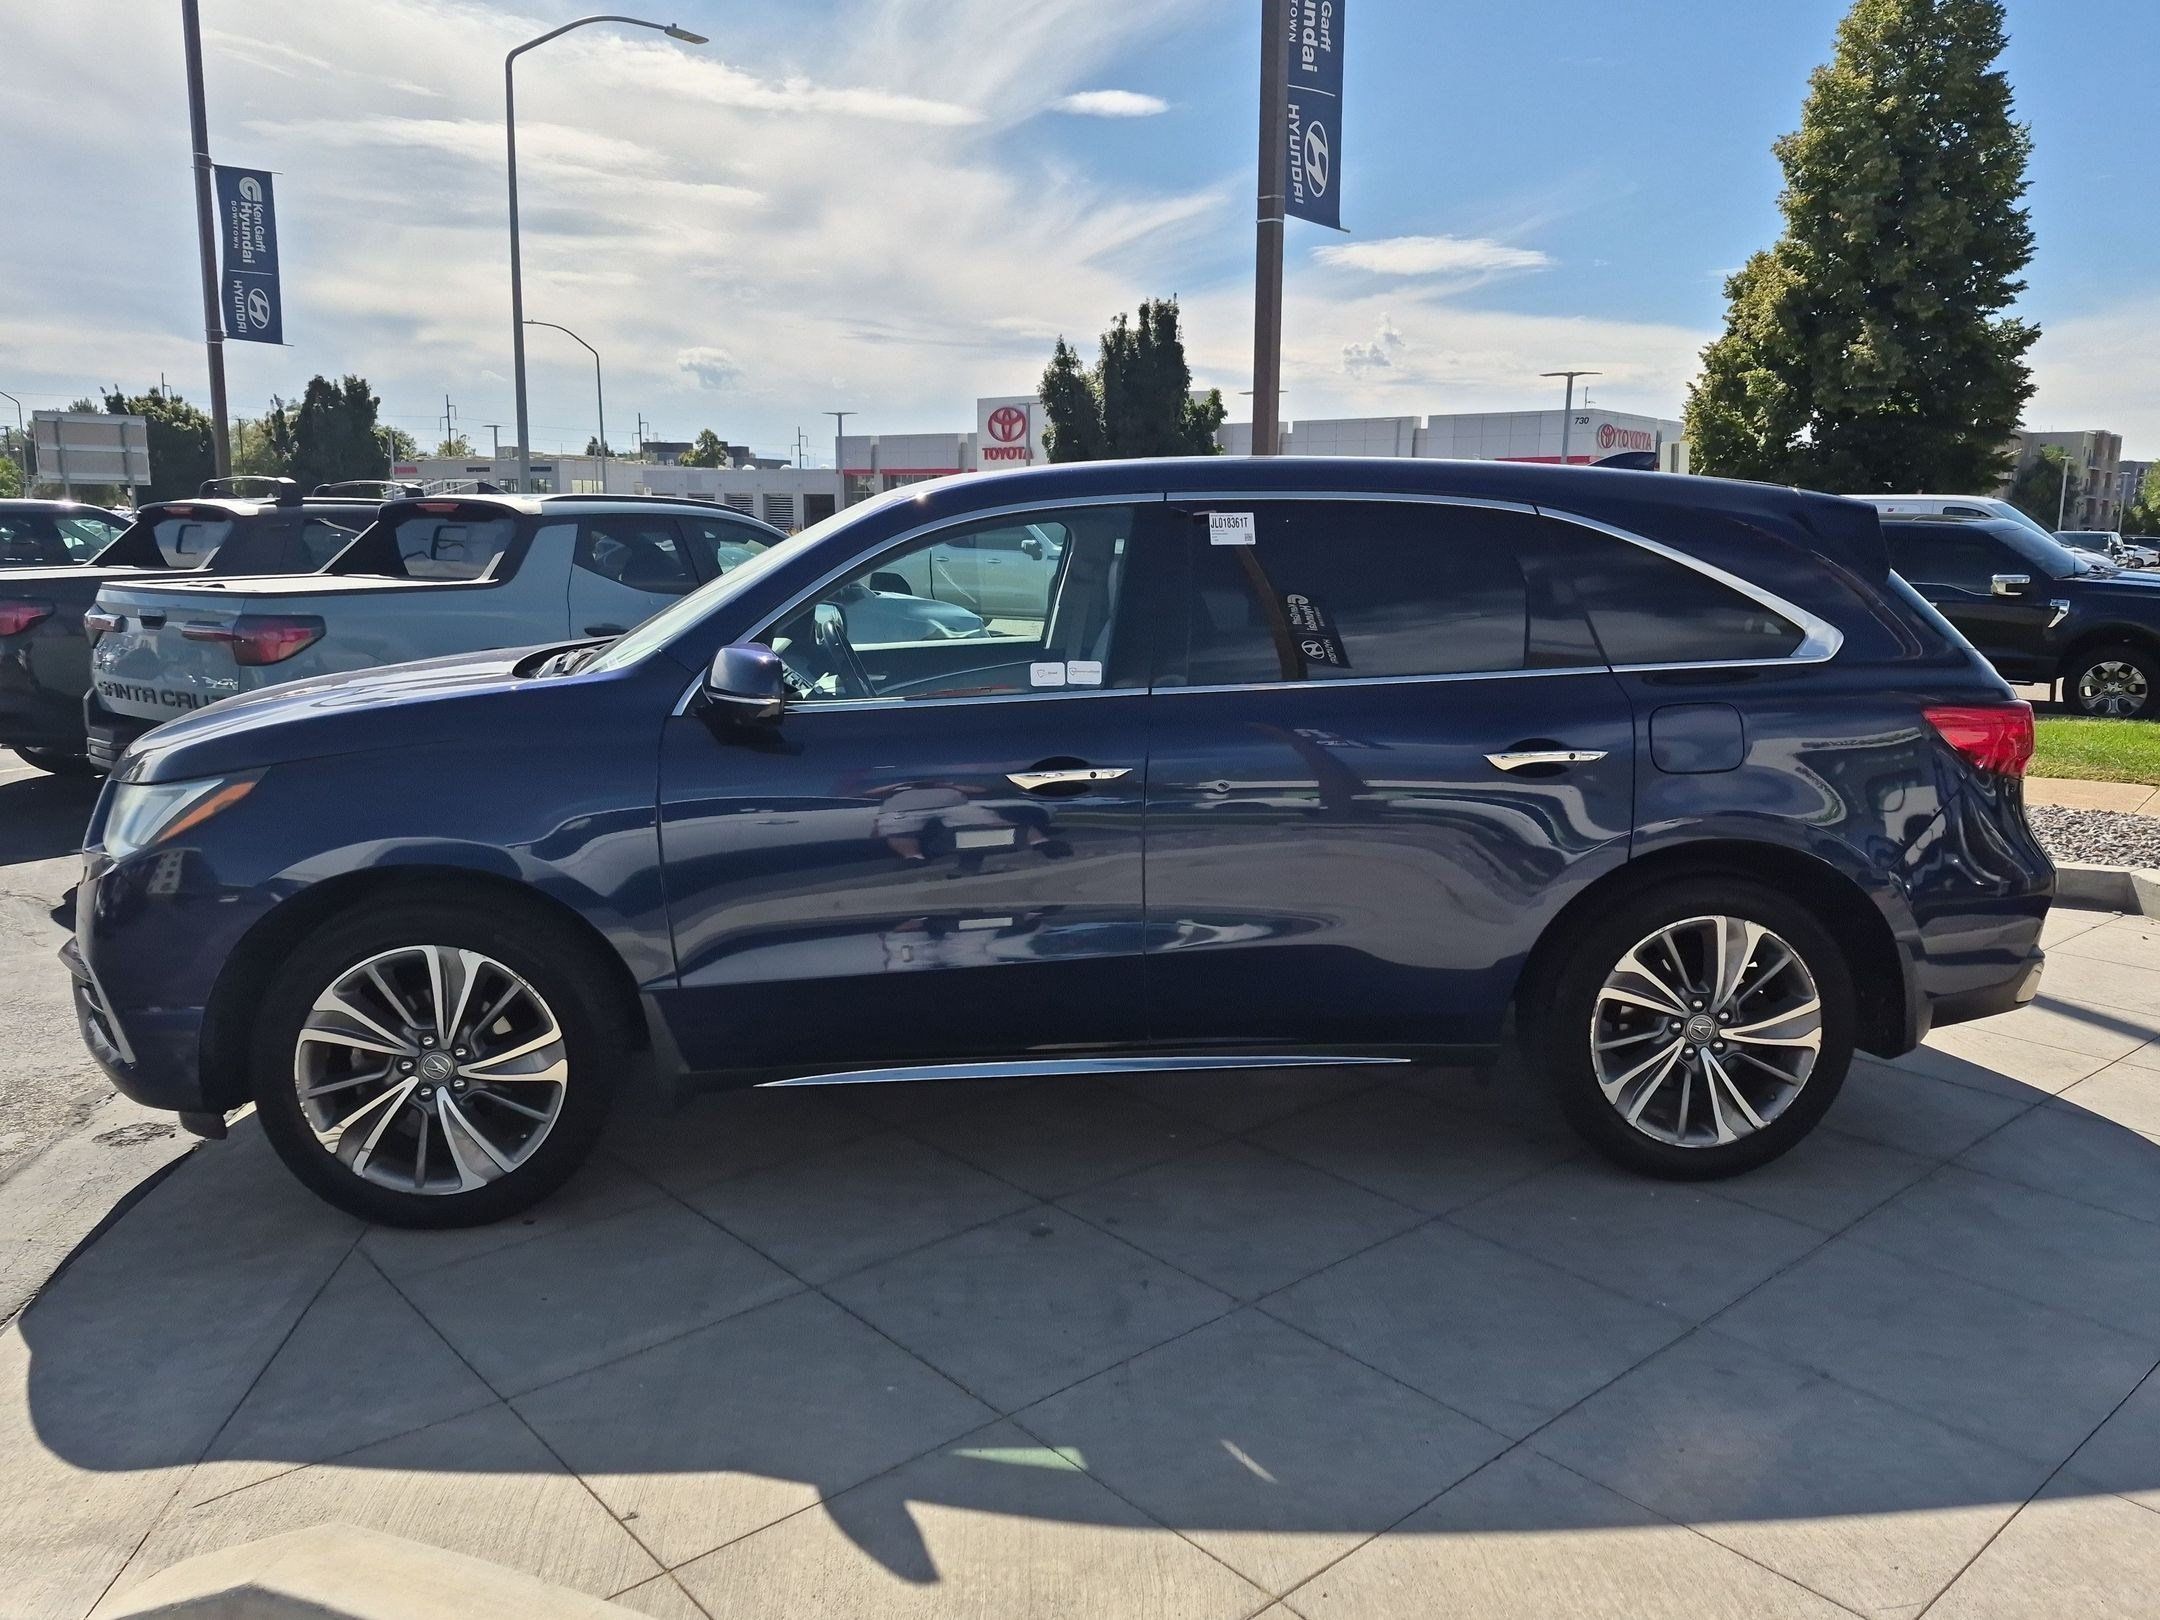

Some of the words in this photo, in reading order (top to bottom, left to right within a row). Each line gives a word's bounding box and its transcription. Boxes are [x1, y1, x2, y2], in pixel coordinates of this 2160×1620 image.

[1289, 0, 1298, 42] TOWN
[1302, 0, 1318, 72] undai
[1321, 1, 1332, 52] Garff
[1288, 103, 1304, 204] HYUNDAI
[231, 200, 239, 249] DOWNTOWN
[239, 201, 255, 263] Hyundai
[253, 203, 264, 225] Ken
[254, 225, 266, 253] Garff
[233, 280, 247, 333] HYUNDAI
[1574, 416, 1590, 425] 730
[1615, 428, 1652, 450] TOYOTA
[982, 446, 1034, 460] TOYOTA
[98, 681, 158, 705] SANTA
